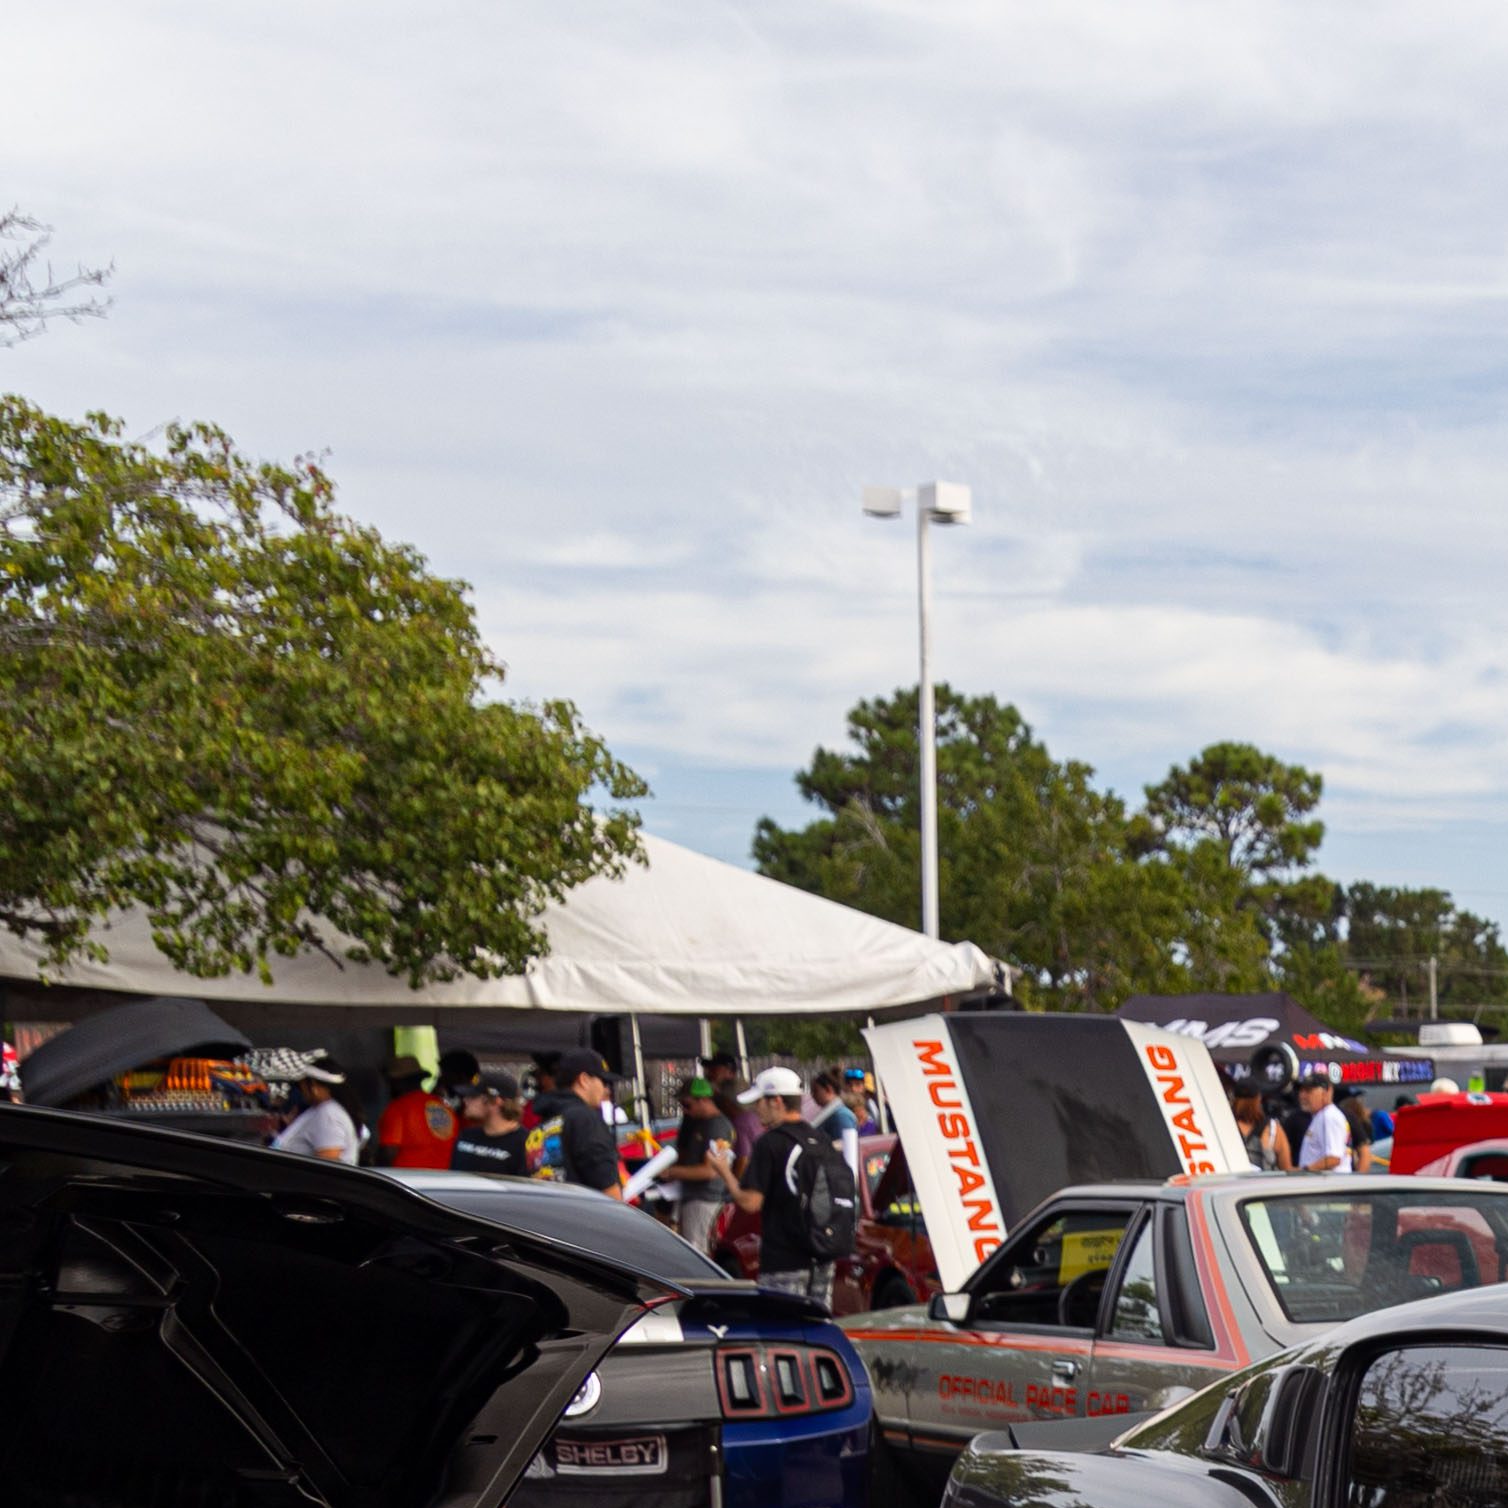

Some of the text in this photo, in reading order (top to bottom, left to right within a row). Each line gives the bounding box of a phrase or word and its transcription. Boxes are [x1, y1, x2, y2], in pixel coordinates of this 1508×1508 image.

[938, 1374, 1019, 1409] OFFICIAL
[1025, 1383, 1079, 1416] PACE
[1086, 1390, 1131, 1418] CAR
[555, 1442, 656, 1465] SHELBY
